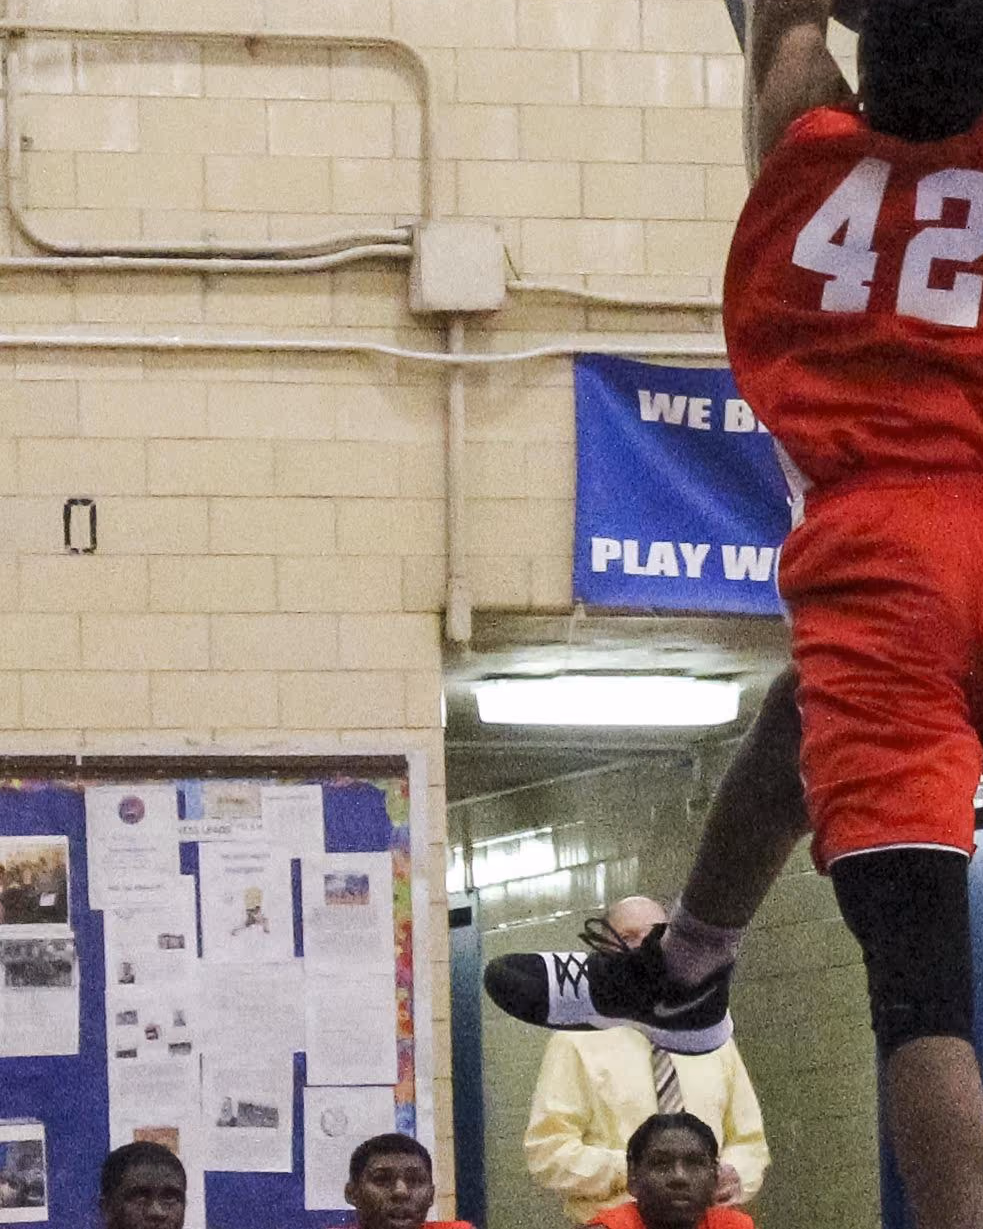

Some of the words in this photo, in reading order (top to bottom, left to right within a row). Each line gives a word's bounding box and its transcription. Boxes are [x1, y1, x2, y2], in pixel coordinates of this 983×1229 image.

[638, 390, 711, 430] WE
[724, 398, 769, 433] B
[591, 536, 710, 578] PLAY
[721, 544, 775, 582] W
